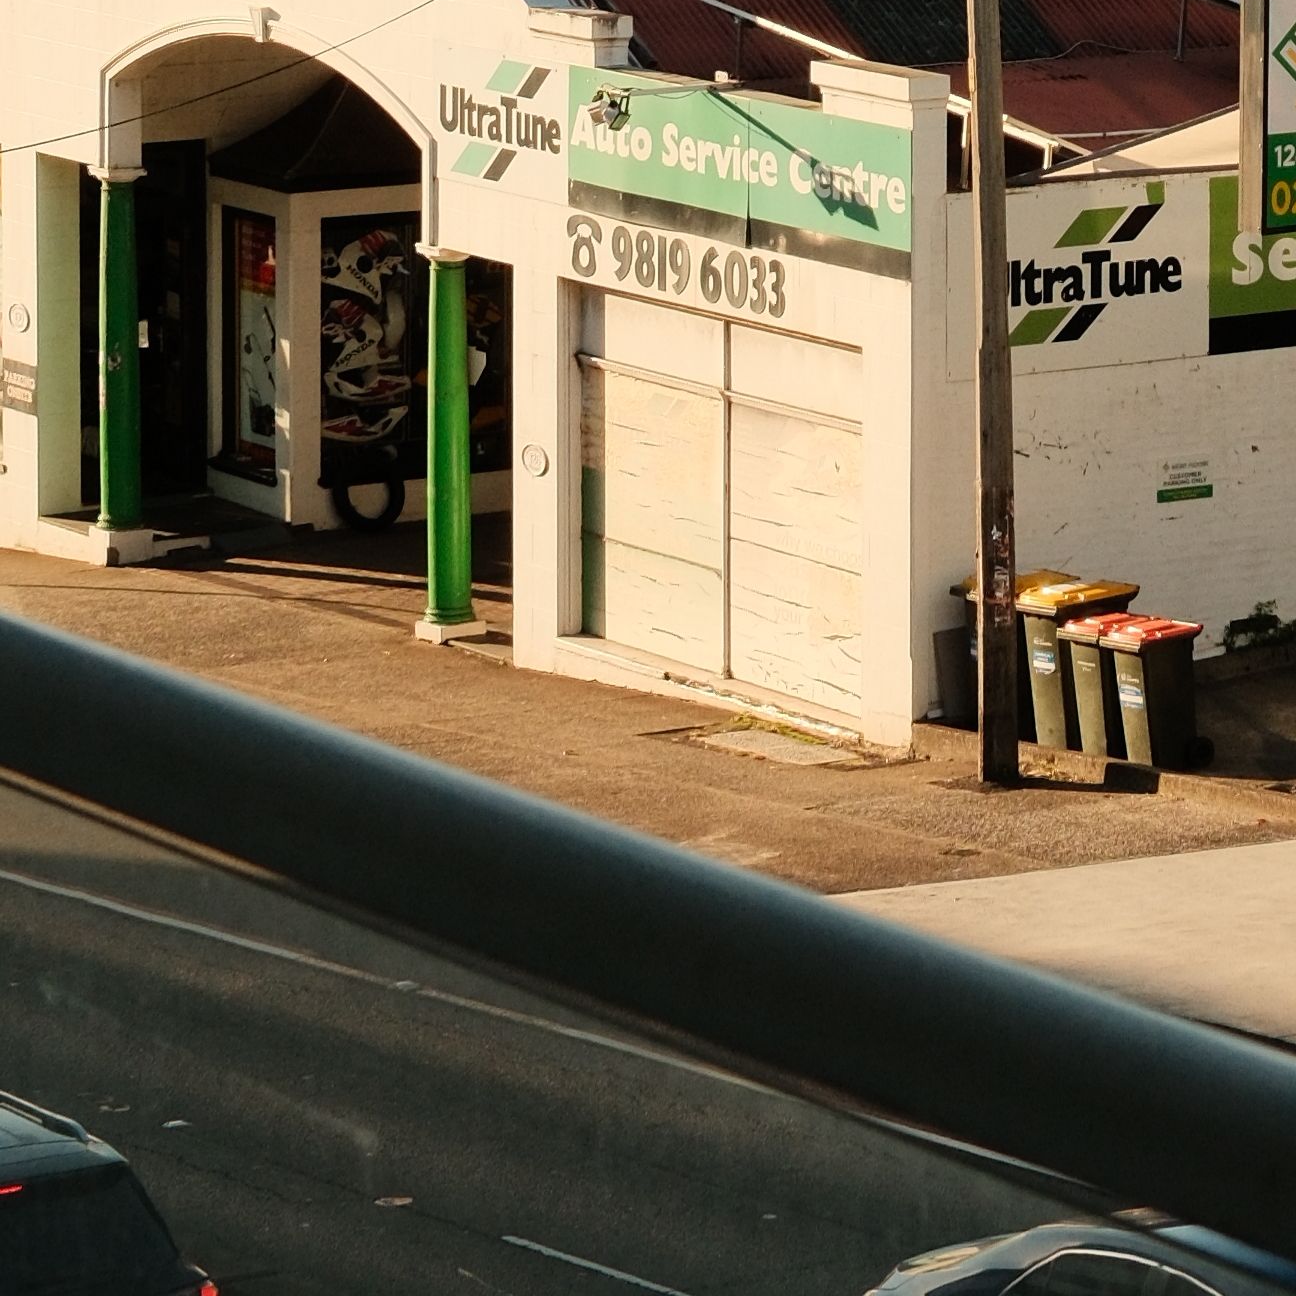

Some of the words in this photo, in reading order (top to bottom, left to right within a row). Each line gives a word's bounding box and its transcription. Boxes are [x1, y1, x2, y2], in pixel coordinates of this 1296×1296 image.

[439, 83, 561, 154] UltraTune
[570, 104, 653, 162] Auto
[661, 121, 778, 187] Service
[789, 148, 906, 213] Centre
[346, 264, 379, 299] HONDA
[611, 224, 691, 296] 9819
[700, 246, 786, 319] 6033
[1007, 250, 1182, 307] ltraTune
[335, 339, 376, 367] HONDA
